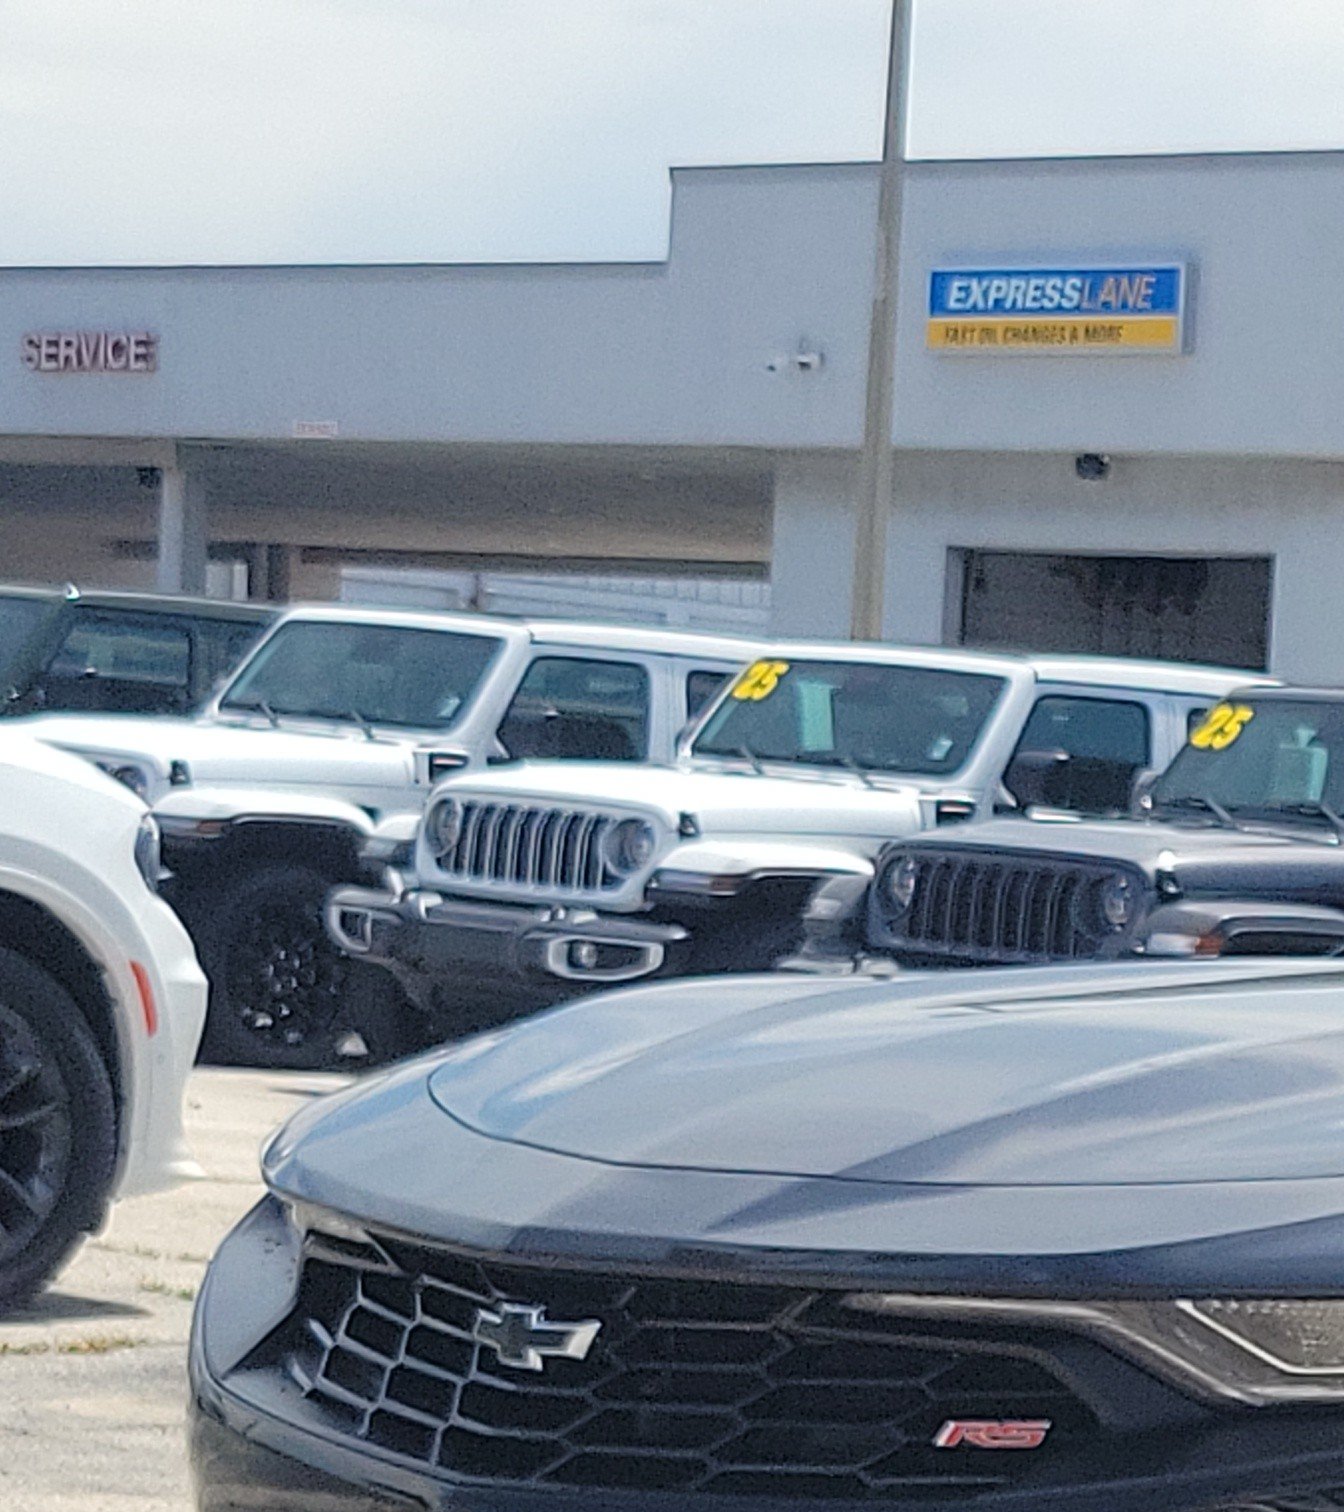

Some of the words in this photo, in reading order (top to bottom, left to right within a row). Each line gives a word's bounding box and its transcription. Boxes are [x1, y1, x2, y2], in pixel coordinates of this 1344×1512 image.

[21, 332, 158, 371] SERVICE
[1084, 323, 1124, 343] MORE
[732, 660, 789, 700] 25
[1189, 703, 1253, 749] 25
[933, 1419, 1052, 1447] RS
